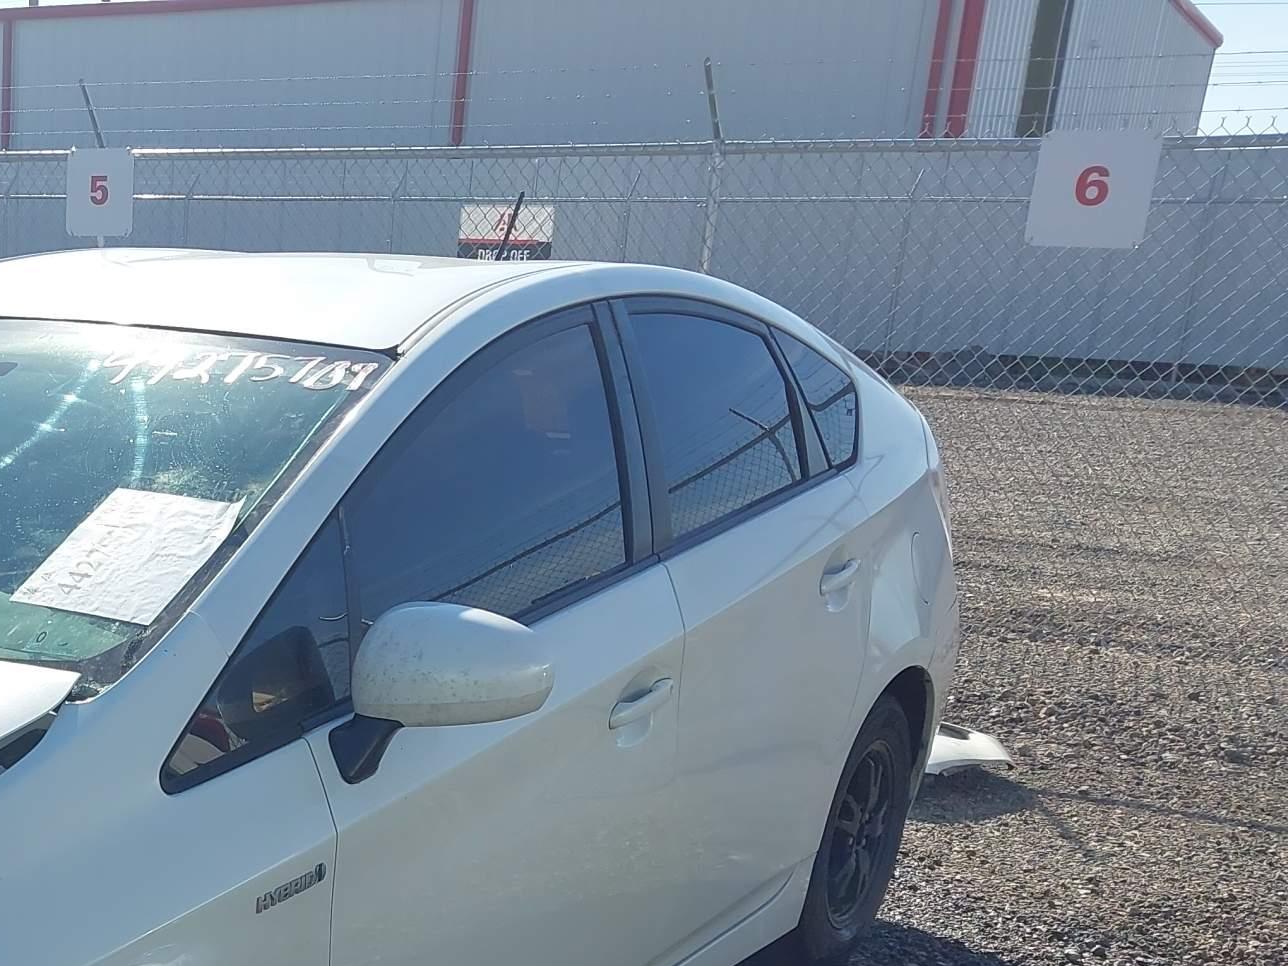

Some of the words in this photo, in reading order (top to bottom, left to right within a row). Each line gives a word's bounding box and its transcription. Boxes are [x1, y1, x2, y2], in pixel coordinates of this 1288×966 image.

[90, 175, 109, 206] 5
[1075, 165, 1110, 207] 6
[510, 249, 530, 261] OFF
[255, 868, 317, 914] HYBRID
